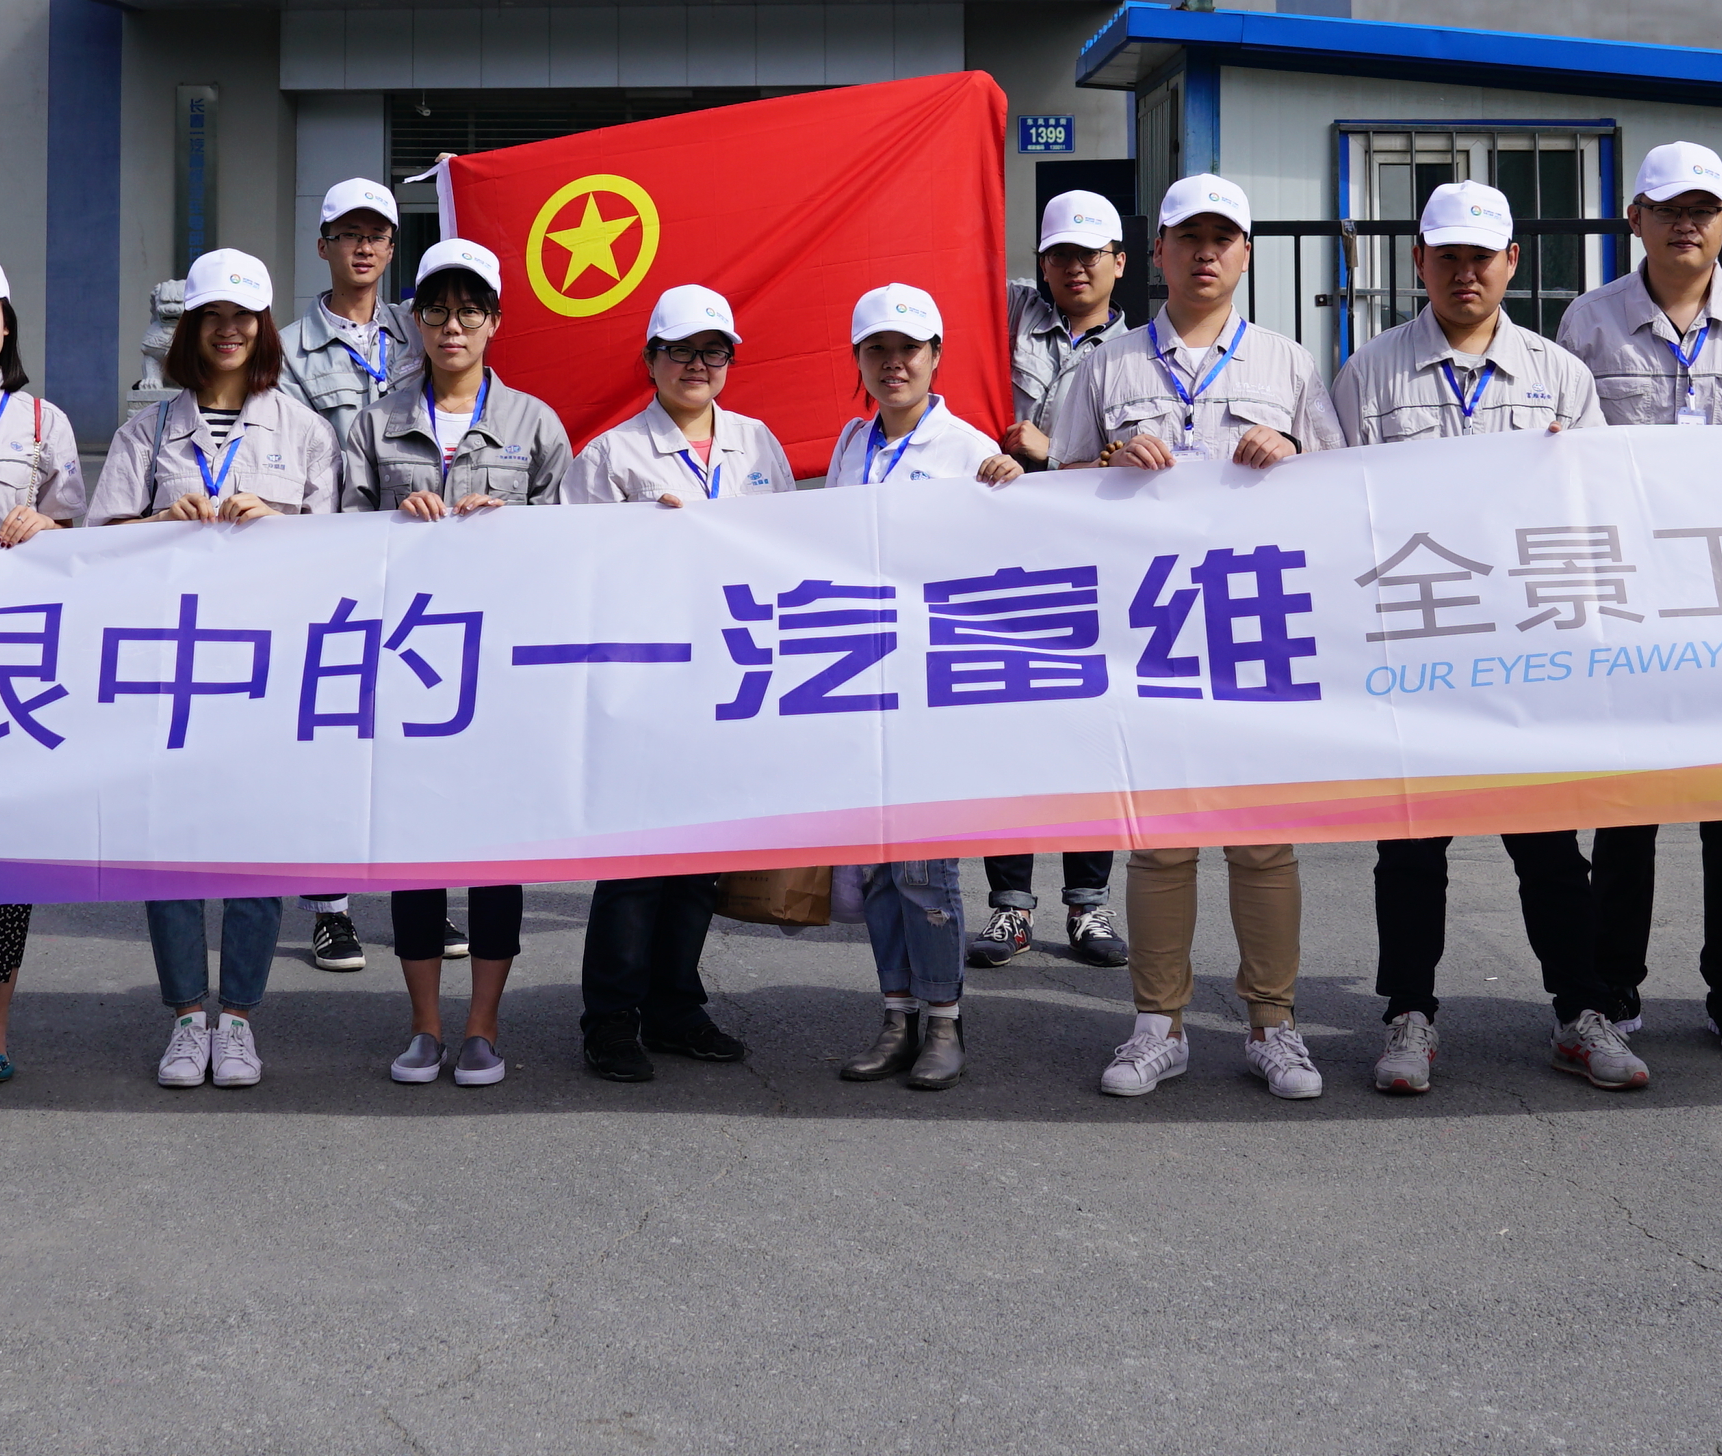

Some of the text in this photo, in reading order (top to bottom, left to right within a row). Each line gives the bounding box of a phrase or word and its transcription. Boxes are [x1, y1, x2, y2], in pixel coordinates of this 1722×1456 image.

[1029, 127, 1065, 143] 1399
[1363, 660, 1457, 697] OUR
[1469, 649, 1574, 688] EYES
